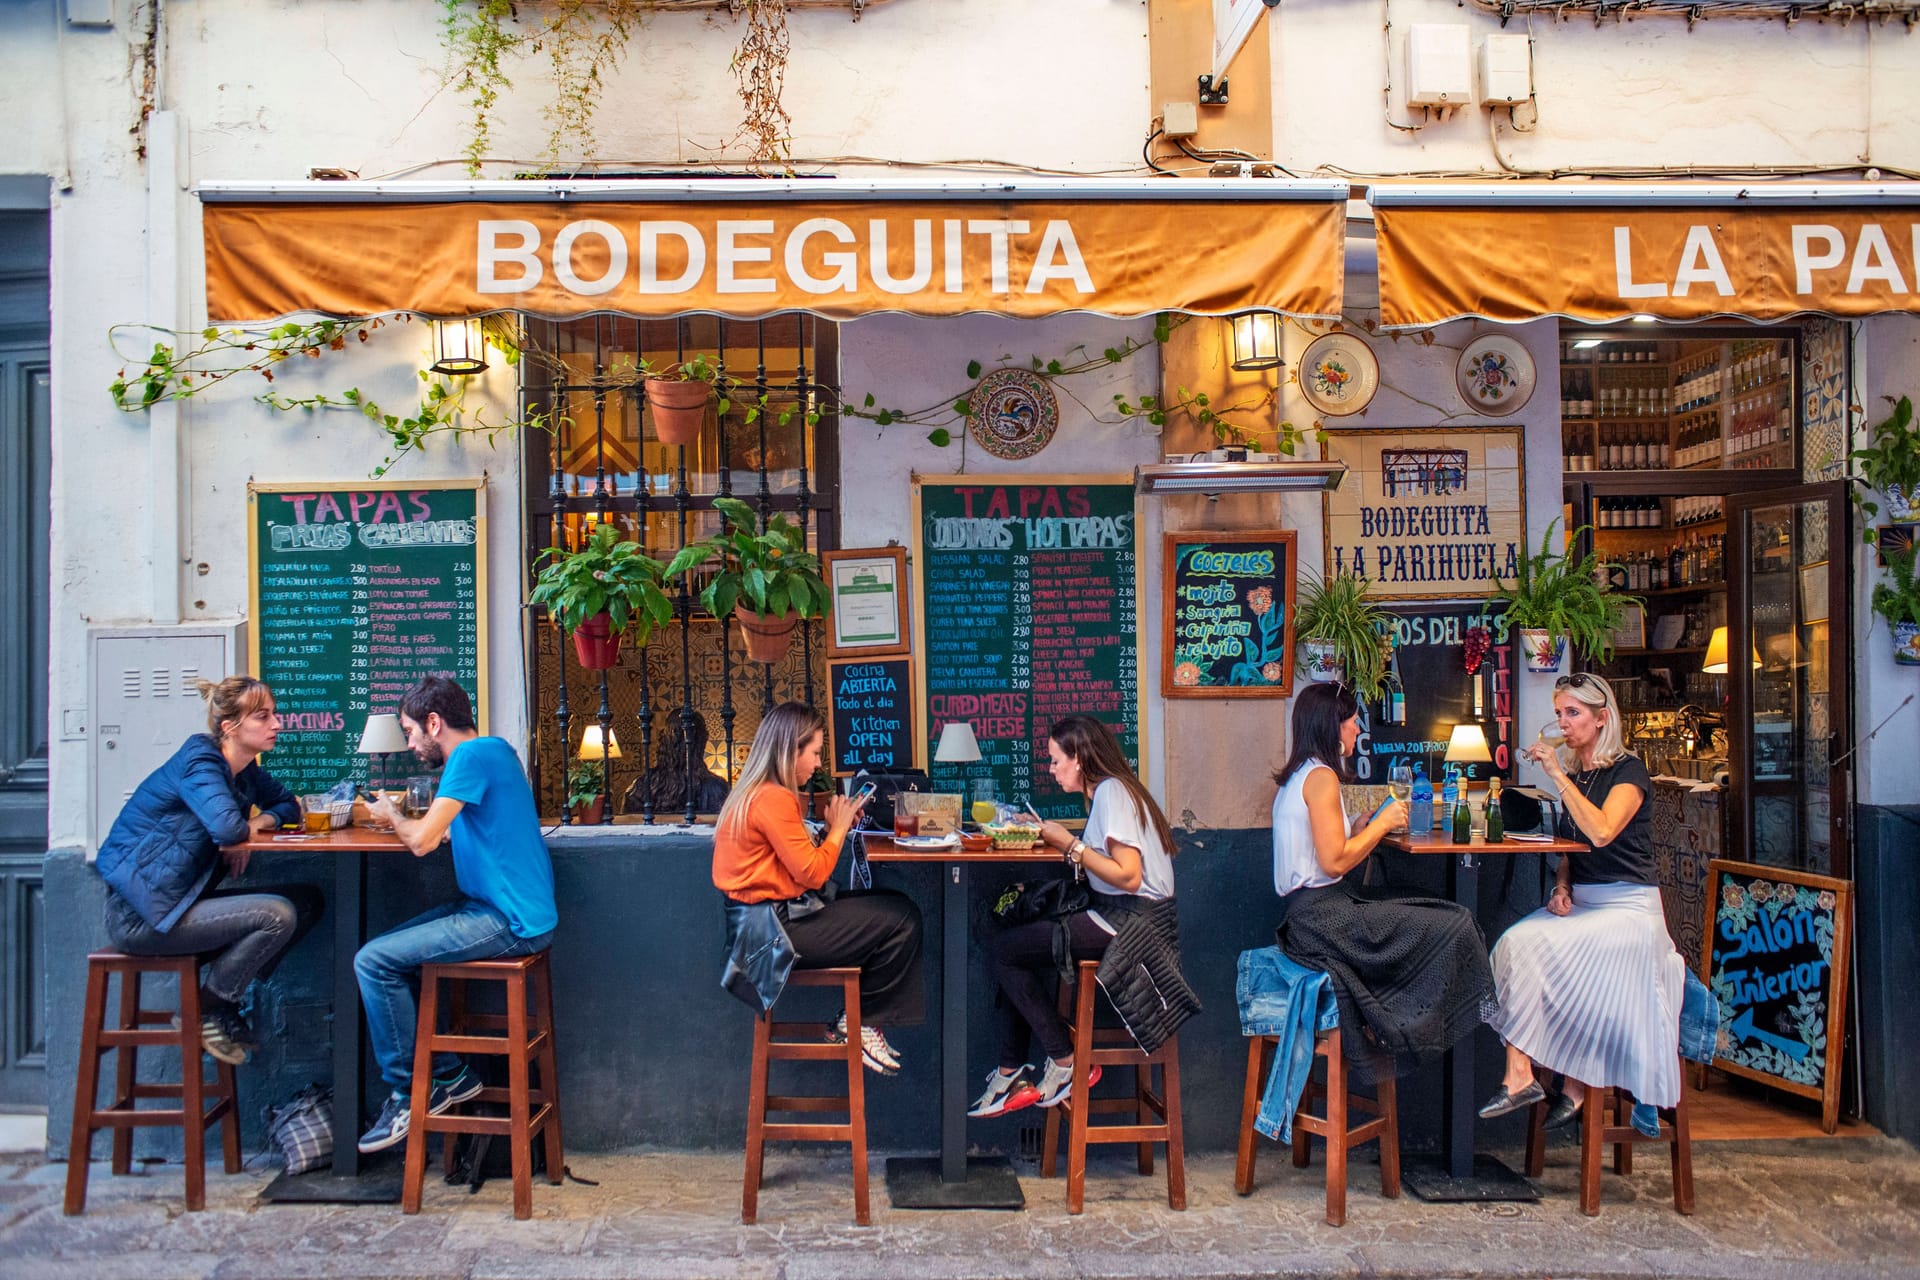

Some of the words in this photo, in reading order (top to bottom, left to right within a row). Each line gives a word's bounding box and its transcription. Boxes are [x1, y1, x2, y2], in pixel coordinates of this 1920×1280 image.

[477, 218, 1096, 295] BODEGUITA
[1614, 225, 1736, 298] LA
[1792, 224, 1920, 295] PA
[281, 491, 431, 524] TAPAS
[954, 487, 1091, 519] TAPAS
[1360, 505, 1491, 537] BODEGUITA
[930, 555, 971, 565] RUSSIAN
[978, 554, 1005, 565] SALAD
[1115, 552, 1135, 561] 2.80
[1333, 546, 1368, 583] LA
[1376, 543, 1520, 583] PARIHUELA
[959, 569, 985, 578] SALAD
[1186, 579, 1236, 606] mojito
[1429, 616, 1465, 646] DEL
[844, 664, 885, 679] Cocina
[1012, 667, 1030, 677] 3.00
[839, 677, 896, 694] ABIERTA
[1012, 678, 1030, 688] 3.00
[835, 696, 860, 710] Todo
[930, 695, 980, 717] CURED
[980, 693, 1027, 715] MEATS
[1493, 646, 1512, 770] TINTO
[851, 715, 900, 733] Kitchen
[848, 732, 893, 747] OPEN
[1373, 742, 1406, 755] HUELVA
[867, 750, 893, 768] day
[1051, 805, 1080, 817] MEATS
[1719, 907, 1815, 966] Salón
[1722, 959, 1827, 1005] Interior
